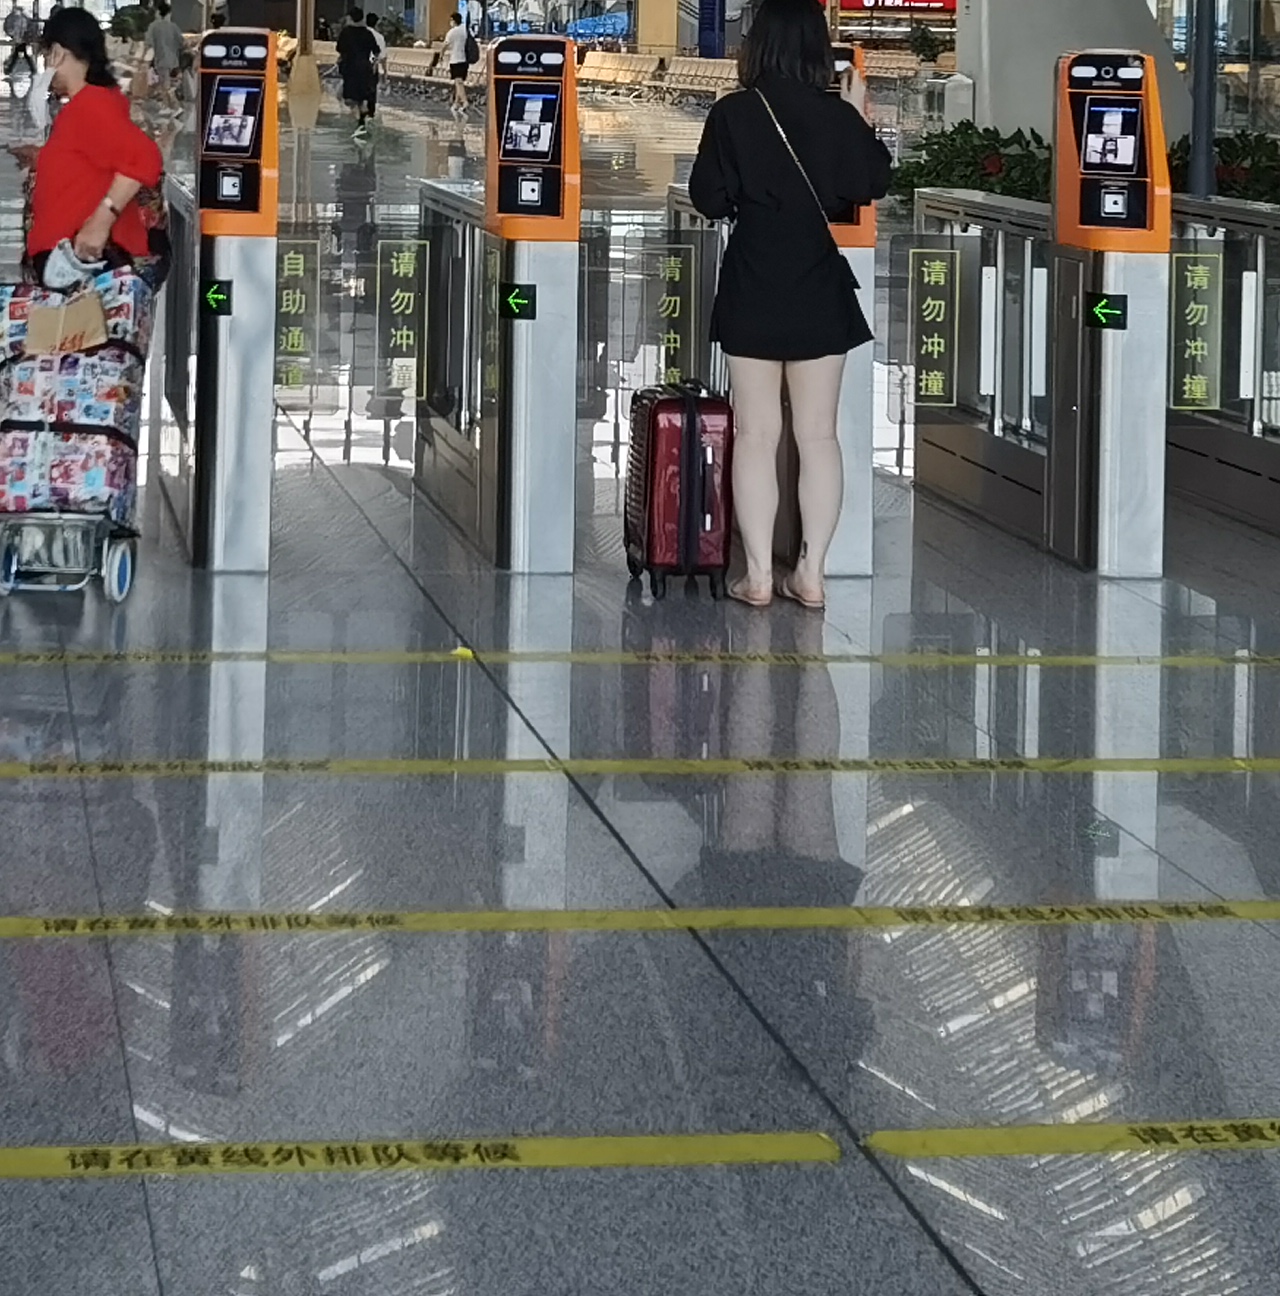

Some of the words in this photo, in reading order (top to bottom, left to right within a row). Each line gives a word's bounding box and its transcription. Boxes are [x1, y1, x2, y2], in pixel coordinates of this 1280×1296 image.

[279, 250, 307, 390] 自助通道
[390, 251, 418, 389] 请勿冲撞
[919, 259, 947, 397] 请勿冲撞
[1182, 264, 1210, 401] 请勿冲撞
[65, 1141, 521, 1172] 请在黄线外排队等候
